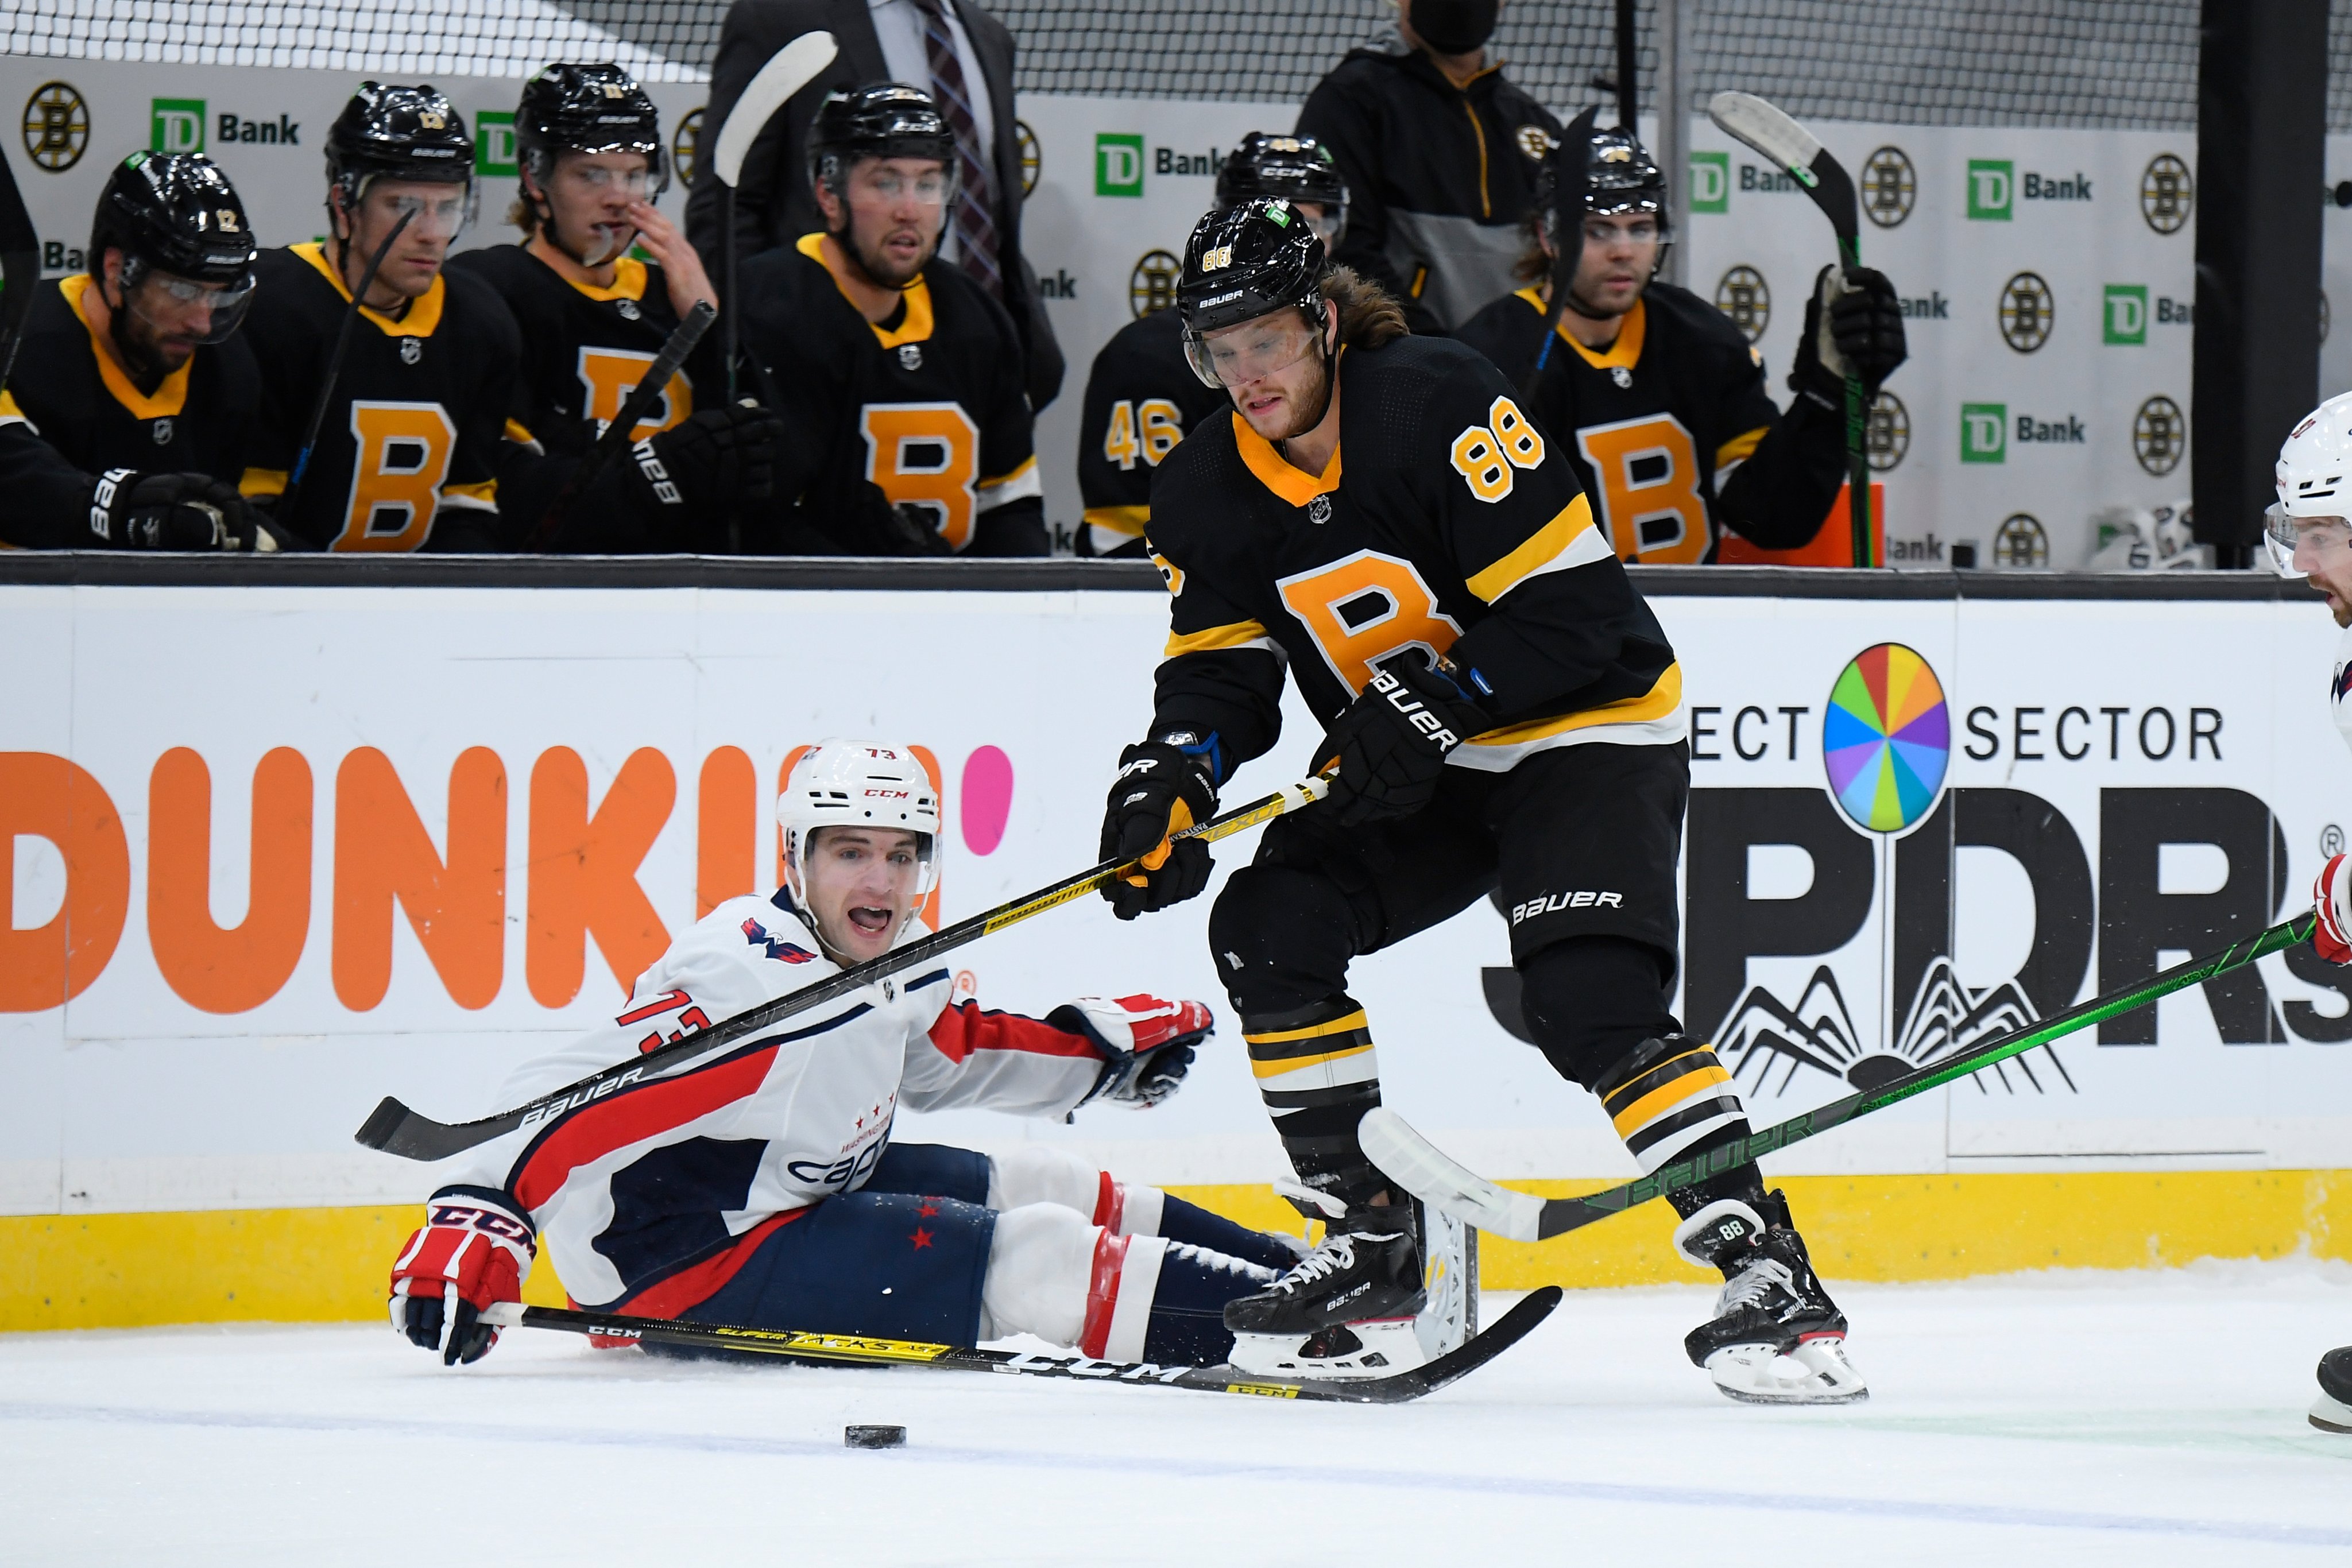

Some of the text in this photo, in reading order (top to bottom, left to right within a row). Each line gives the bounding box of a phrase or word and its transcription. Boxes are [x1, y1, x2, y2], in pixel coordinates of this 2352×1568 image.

[156, 111, 301, 152] TD Bank
[1100, 145, 1228, 185] TD Bank
[1740, 164, 1802, 192] Ban
[1972, 172, 2092, 210] TD Bank
[44, 241, 85, 270] Ba
[1202, 243, 1232, 272] 88
[1037, 270, 1076, 300] nk
[1200, 290, 1243, 308] BAUER
[1898, 291, 1949, 319] ank
[2108, 296, 2193, 334] TD Ba
[1105, 398, 1184, 471] 46
[1450, 394, 1545, 504] 88
[1966, 414, 2086, 452] TD Bank
[328, 400, 458, 552] B
[860, 401, 980, 553] B
[1576, 412, 1713, 564] B
[1885, 533, 1945, 562] ank
[1275, 548, 1464, 704] B
[1369, 669, 1459, 752] AUER
[1691, 706, 2223, 761] ECT SECTOR
[864, 748, 897, 760] 73
[864, 789, 909, 799] CCM
[1194, 772, 1215, 803] BAUER
[1512, 891, 1624, 927] BAUER
[517, 1066, 644, 1130] BAUER
[1626, 1112, 1815, 1210] BAUER
[431, 1205, 537, 1263] CCM
[1719, 1220, 1745, 1241] 88
[587, 1325, 642, 1339] CCM
[716, 1327, 788, 1341] SUPER
[1008, 1352, 1193, 1384] CCM
[1237, 1387, 1287, 1398] CCM
